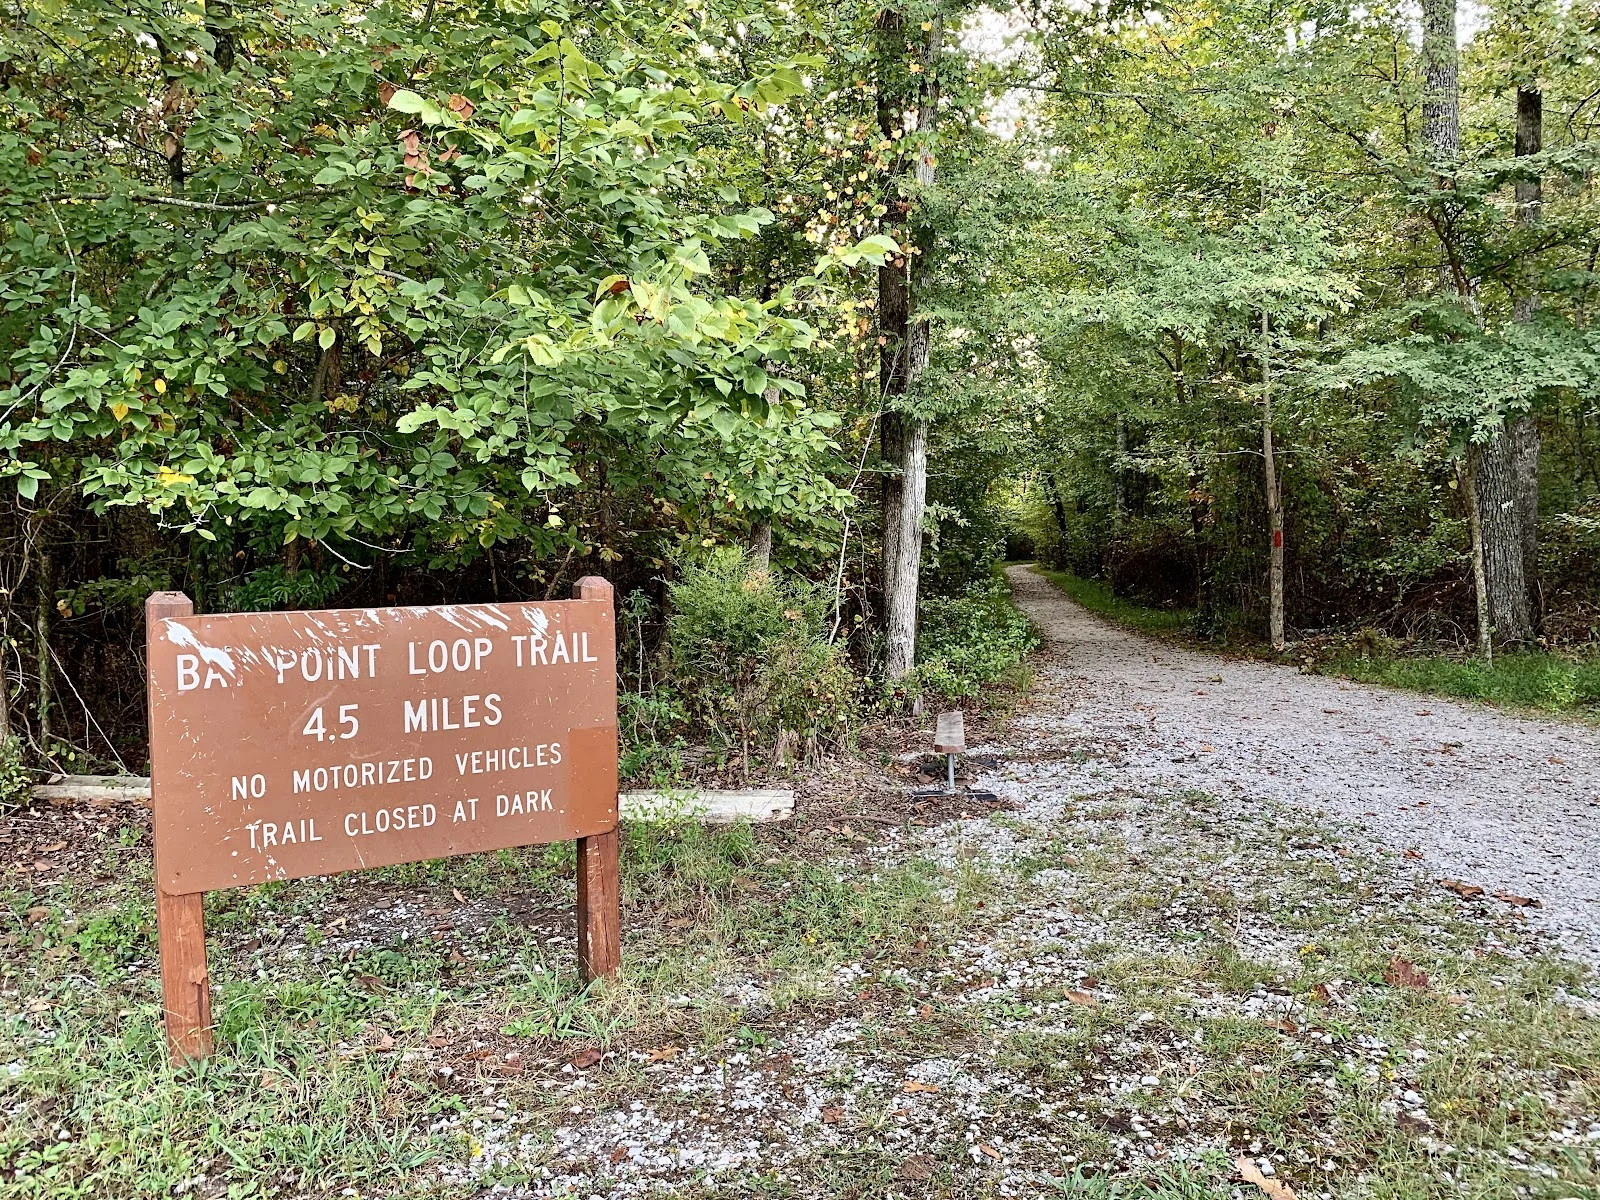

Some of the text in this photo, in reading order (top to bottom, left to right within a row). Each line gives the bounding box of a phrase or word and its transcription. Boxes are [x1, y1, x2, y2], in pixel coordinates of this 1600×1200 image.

[176, 631, 598, 691] BA POINT LOOP TRAIL
[302, 693, 503, 742] 4.5 MILES
[231, 742, 562, 801] NO MOTORIZED VEHICLES
[247, 818, 323, 849] TRAIL
[344, 803, 437, 837] CLOSED
[453, 798, 479, 823] AT
